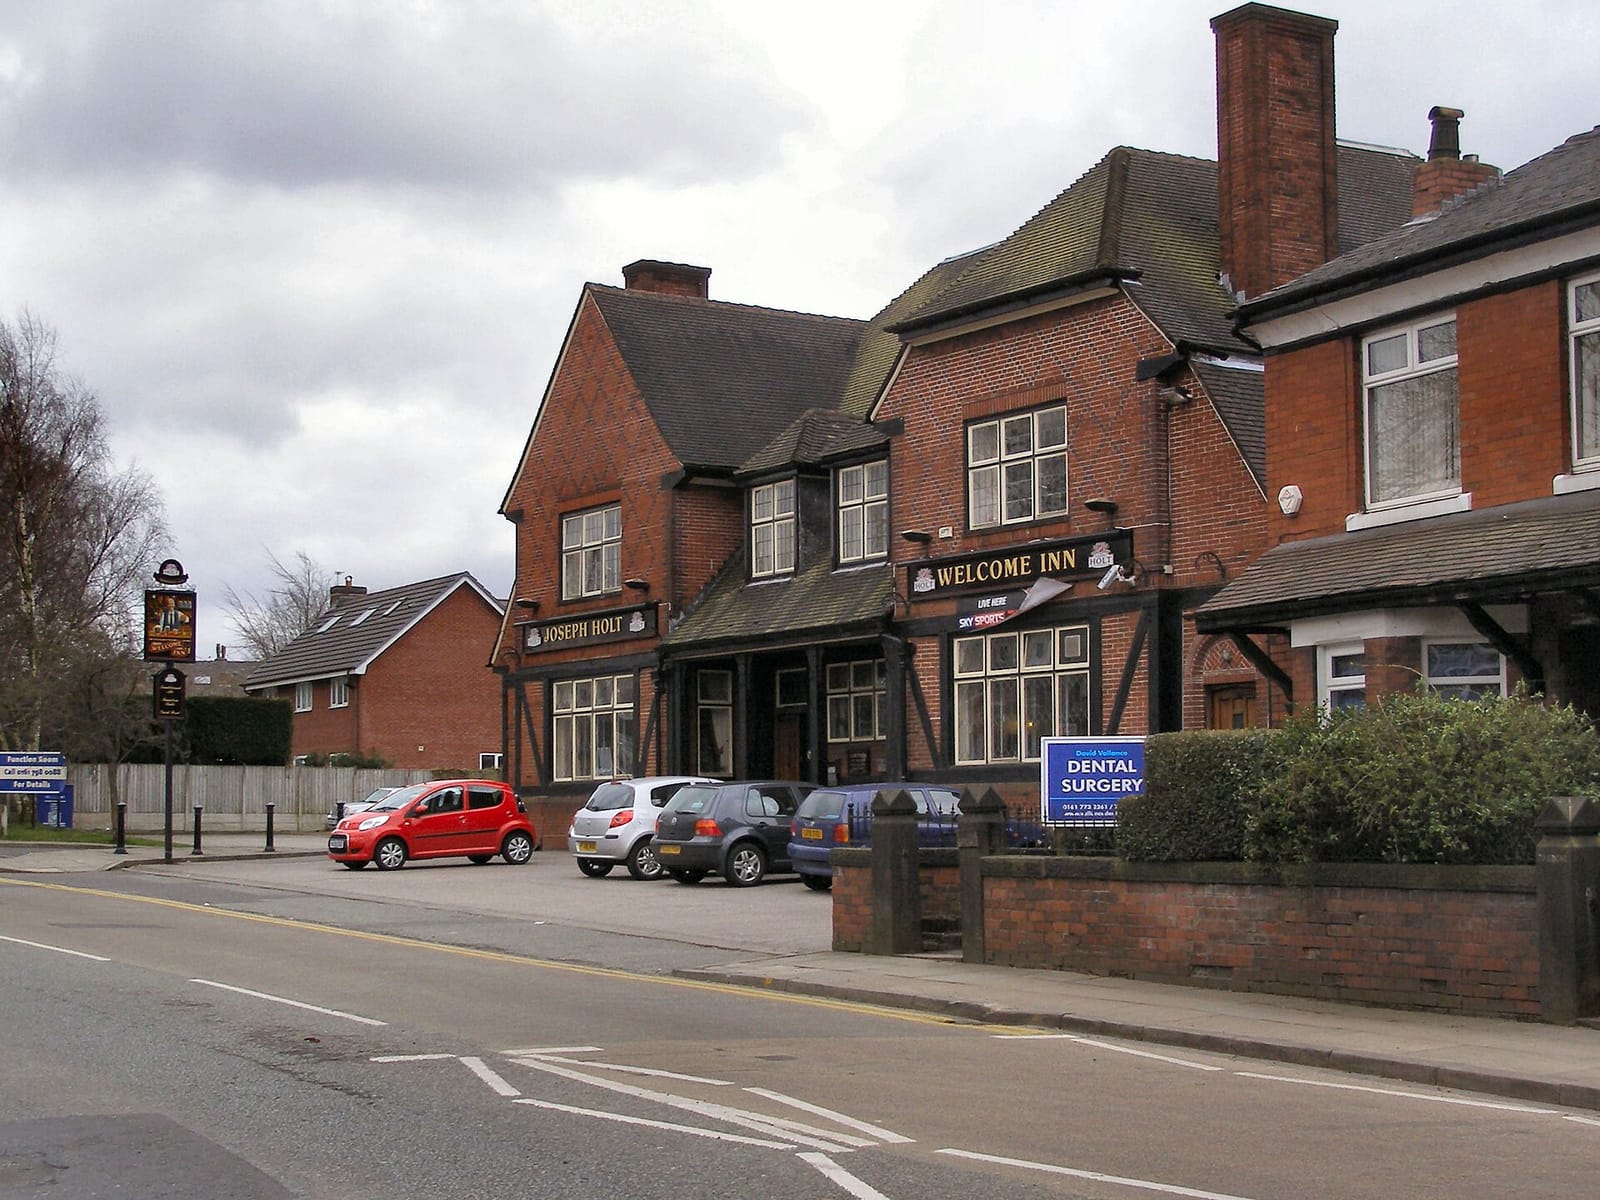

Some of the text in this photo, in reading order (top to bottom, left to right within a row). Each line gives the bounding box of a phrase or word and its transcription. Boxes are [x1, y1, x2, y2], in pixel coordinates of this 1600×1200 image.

[937, 548, 1076, 586] WELCOME INN
[1089, 556, 1112, 567] HOLT
[977, 596, 1008, 609] LIVE HERE
[959, 612, 1005, 629] SKY SPORTS
[543, 621, 588, 643] JOSEPH
[592, 616, 623, 636] HOLT
[1067, 760, 1137, 773] DENTAL
[13, 780, 51, 788] For Details
[1061, 778, 1143, 792] SURGERY
